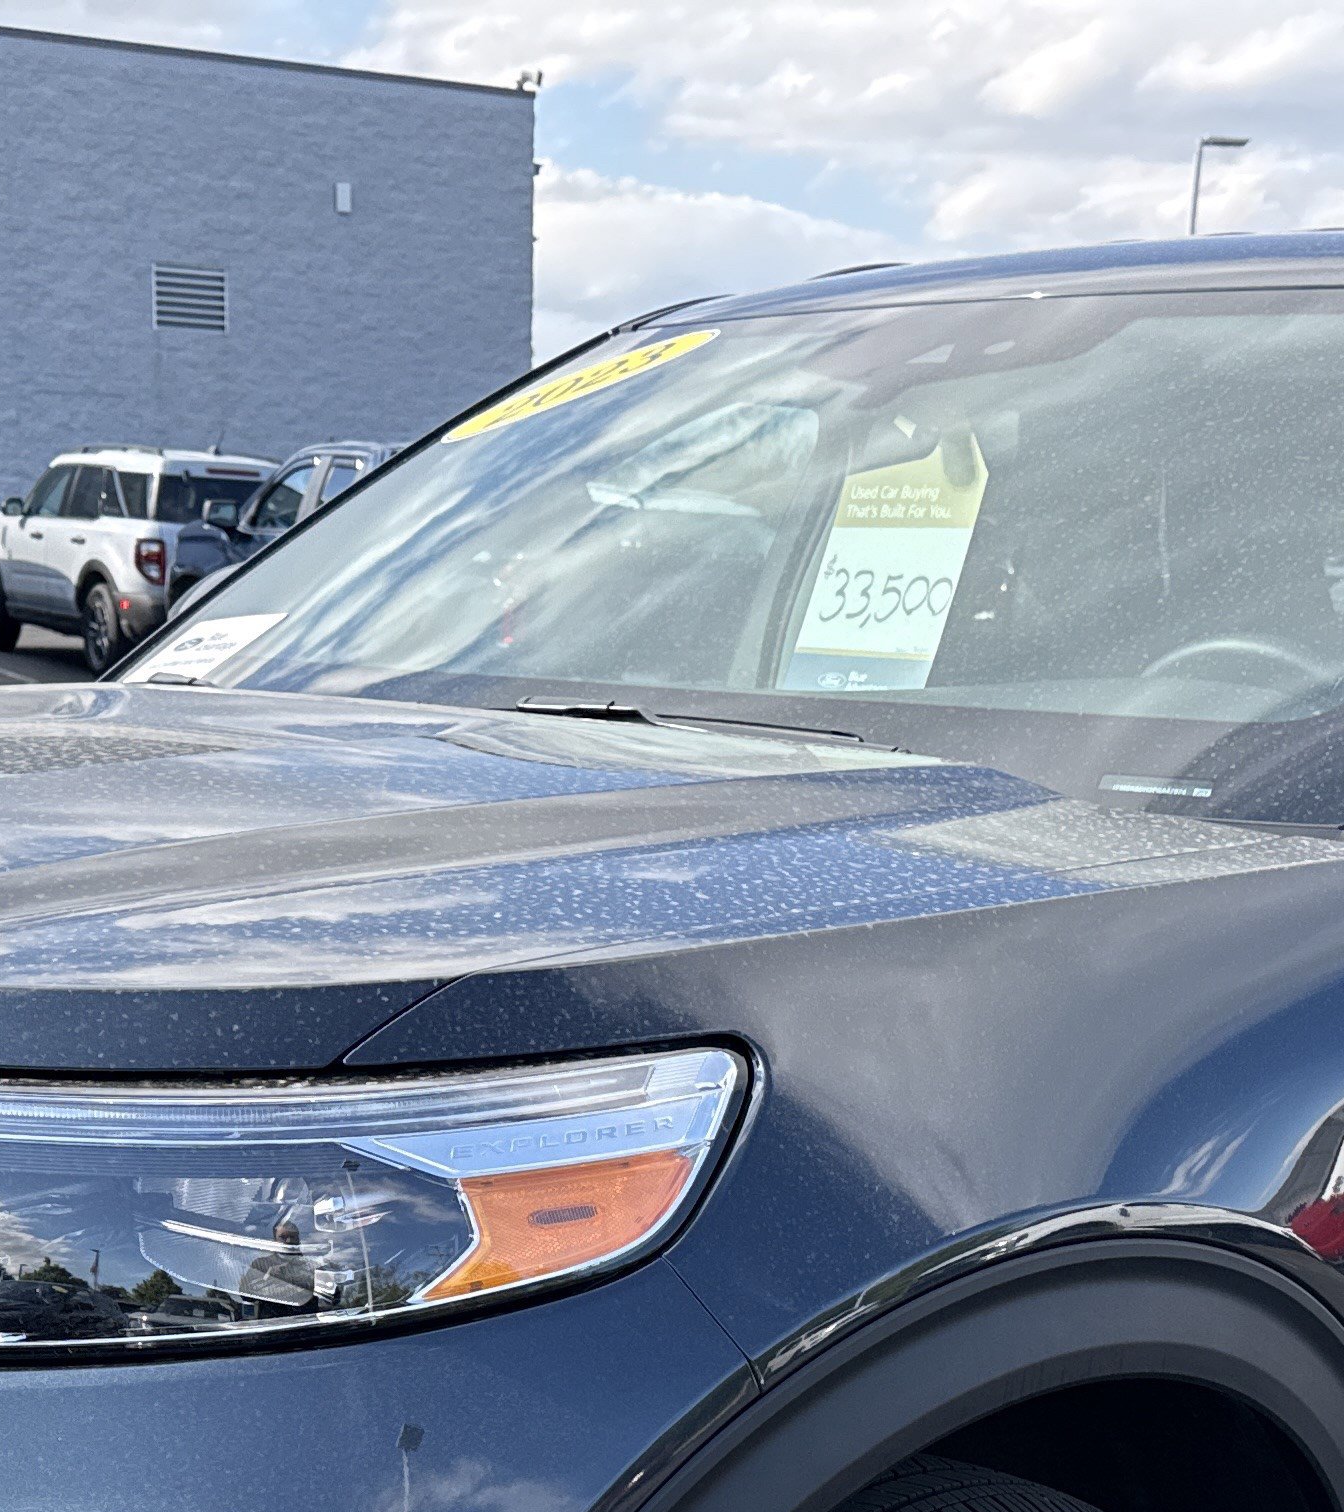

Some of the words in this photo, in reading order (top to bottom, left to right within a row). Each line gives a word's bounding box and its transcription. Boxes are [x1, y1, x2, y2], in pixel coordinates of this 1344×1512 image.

[483, 342, 677, 429] 2023
[850, 485, 878, 500] Used
[880, 485, 899, 499] Car
[900, 484, 940, 502] Buying
[846, 504, 878, 518] That's
[879, 504, 906, 519] Built
[906, 504, 927, 518] For
[450, 1115, 674, 1160] EXPLORER
